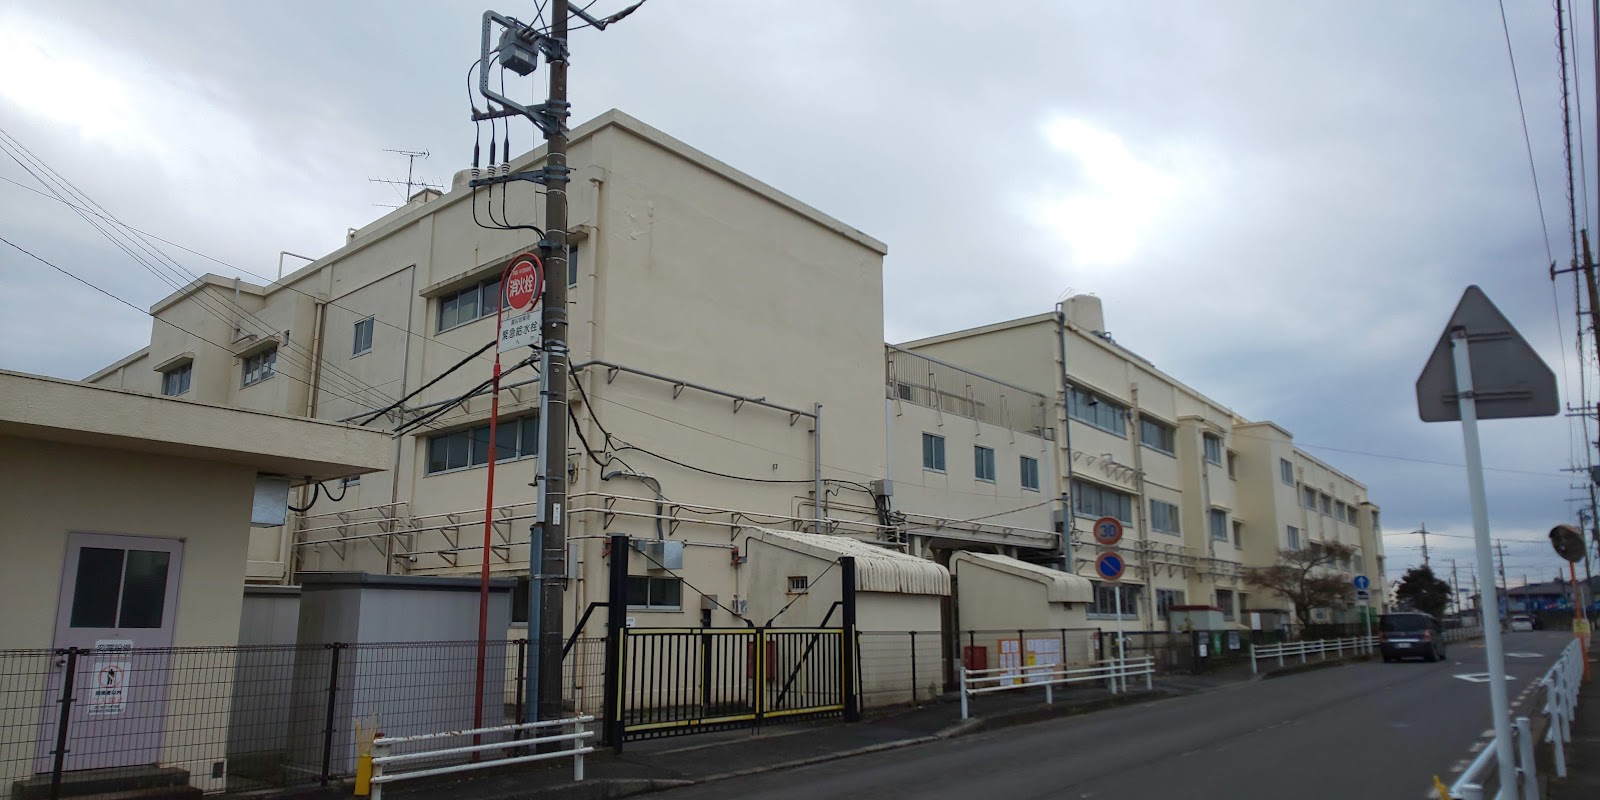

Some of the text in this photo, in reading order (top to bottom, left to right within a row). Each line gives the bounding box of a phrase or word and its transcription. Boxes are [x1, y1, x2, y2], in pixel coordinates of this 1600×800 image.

[509, 274, 534, 297] 消火栓
[502, 321, 538, 340] 緊急給水栓
[1100, 524, 1116, 537] 30
